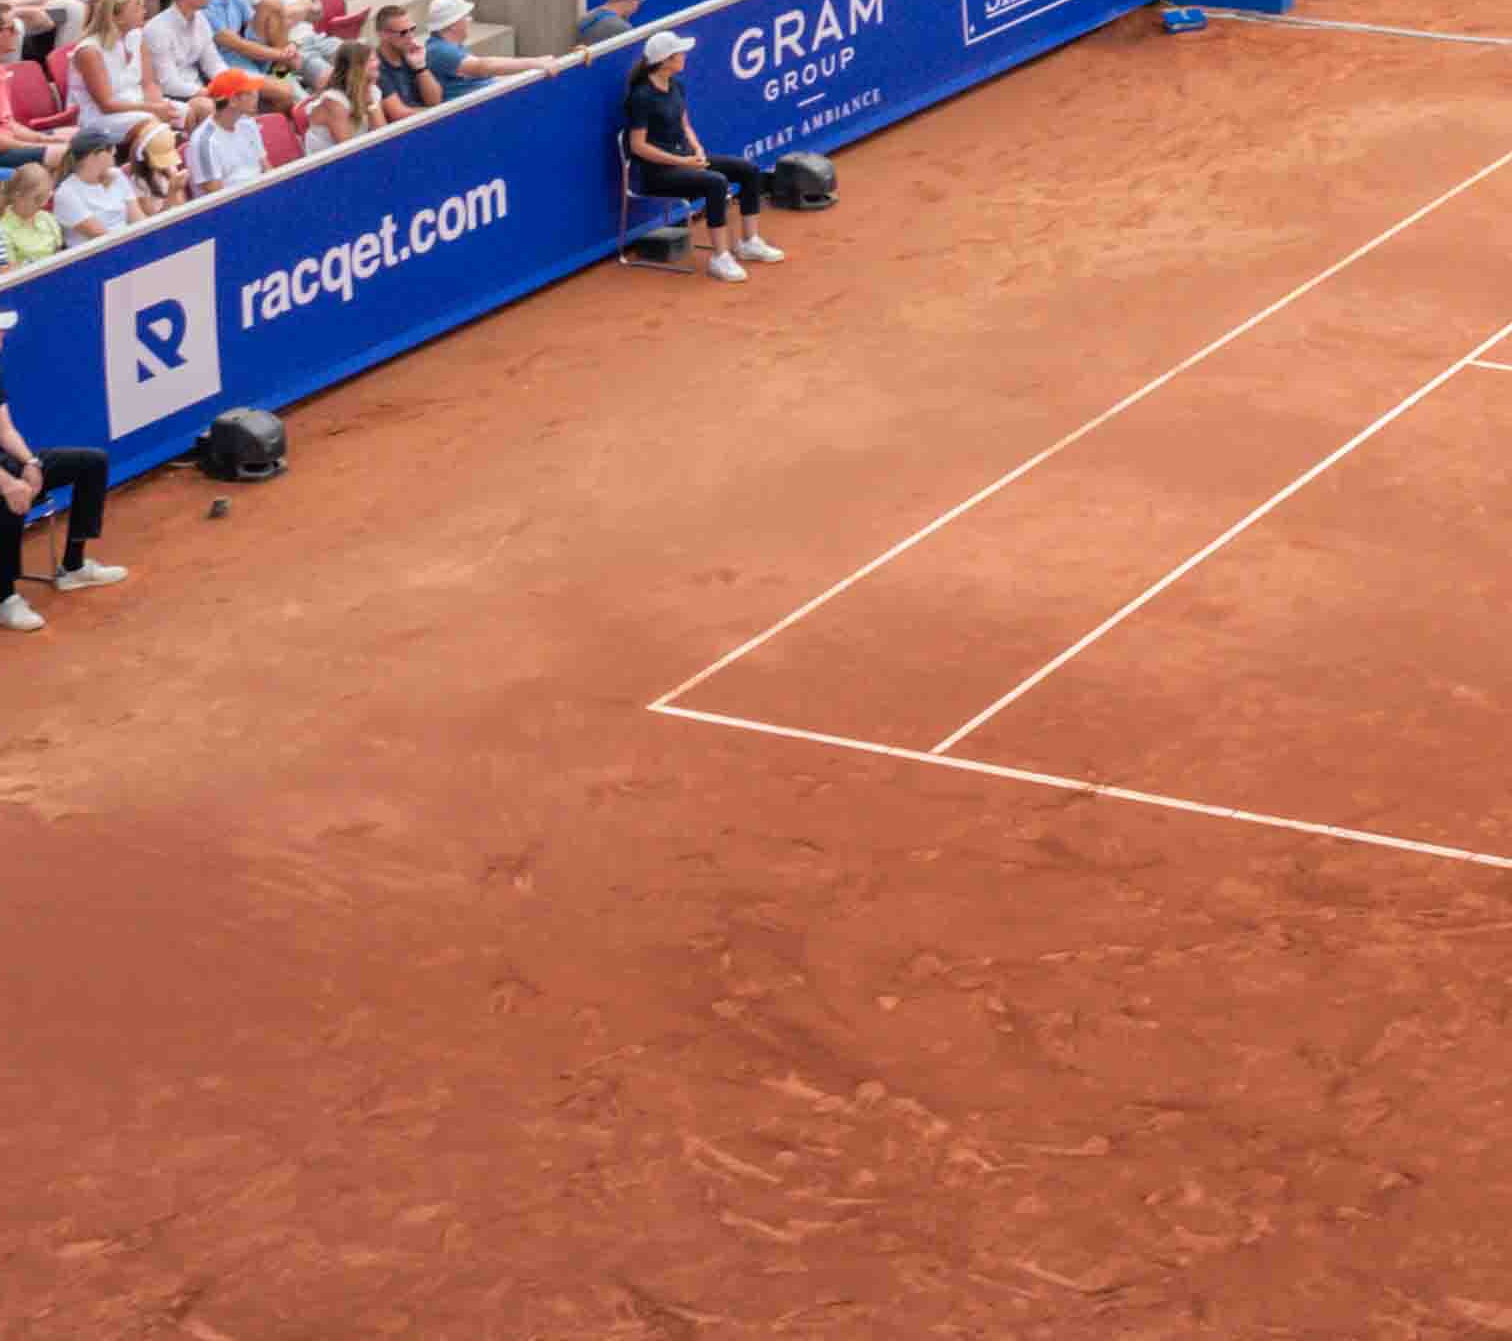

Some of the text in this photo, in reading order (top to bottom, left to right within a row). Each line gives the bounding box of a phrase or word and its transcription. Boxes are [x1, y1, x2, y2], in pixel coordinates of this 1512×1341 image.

[764, 47, 855, 103] GROUP
[743, 88, 881, 160] GREAT AMBIANCE
[240, 177, 508, 330] racqet.com
